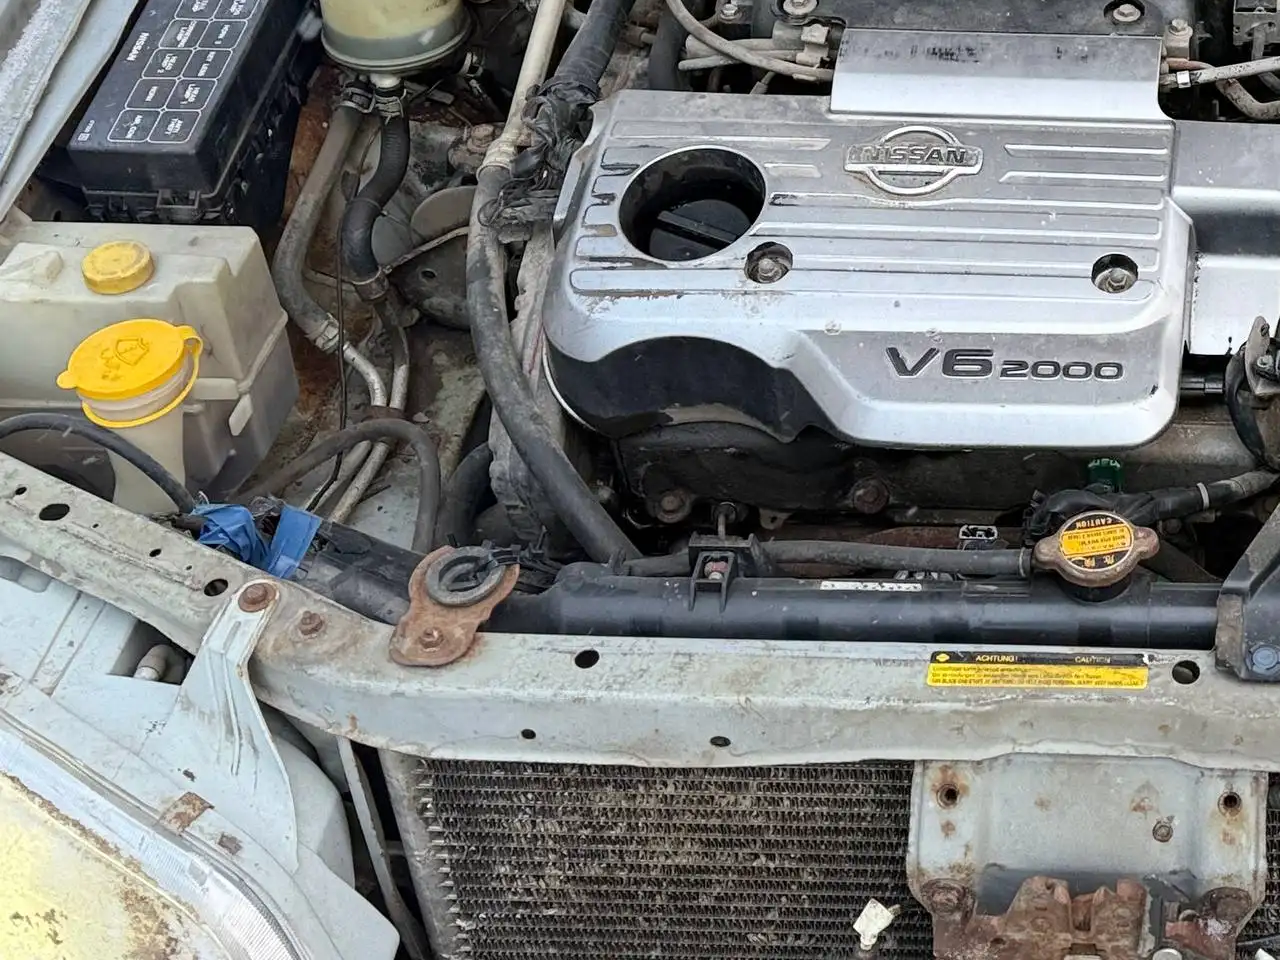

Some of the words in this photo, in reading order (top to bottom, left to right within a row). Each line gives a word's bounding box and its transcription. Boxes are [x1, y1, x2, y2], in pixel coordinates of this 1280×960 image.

[127, 32, 149, 61] NISSAN
[861, 144, 967, 164] NISSAN
[885, 346, 994, 378] V6
[999, 360, 1125, 381] 2000
[1075, 517, 1113, 529] CAUTION
[1074, 655, 1111, 664] CAUTION
